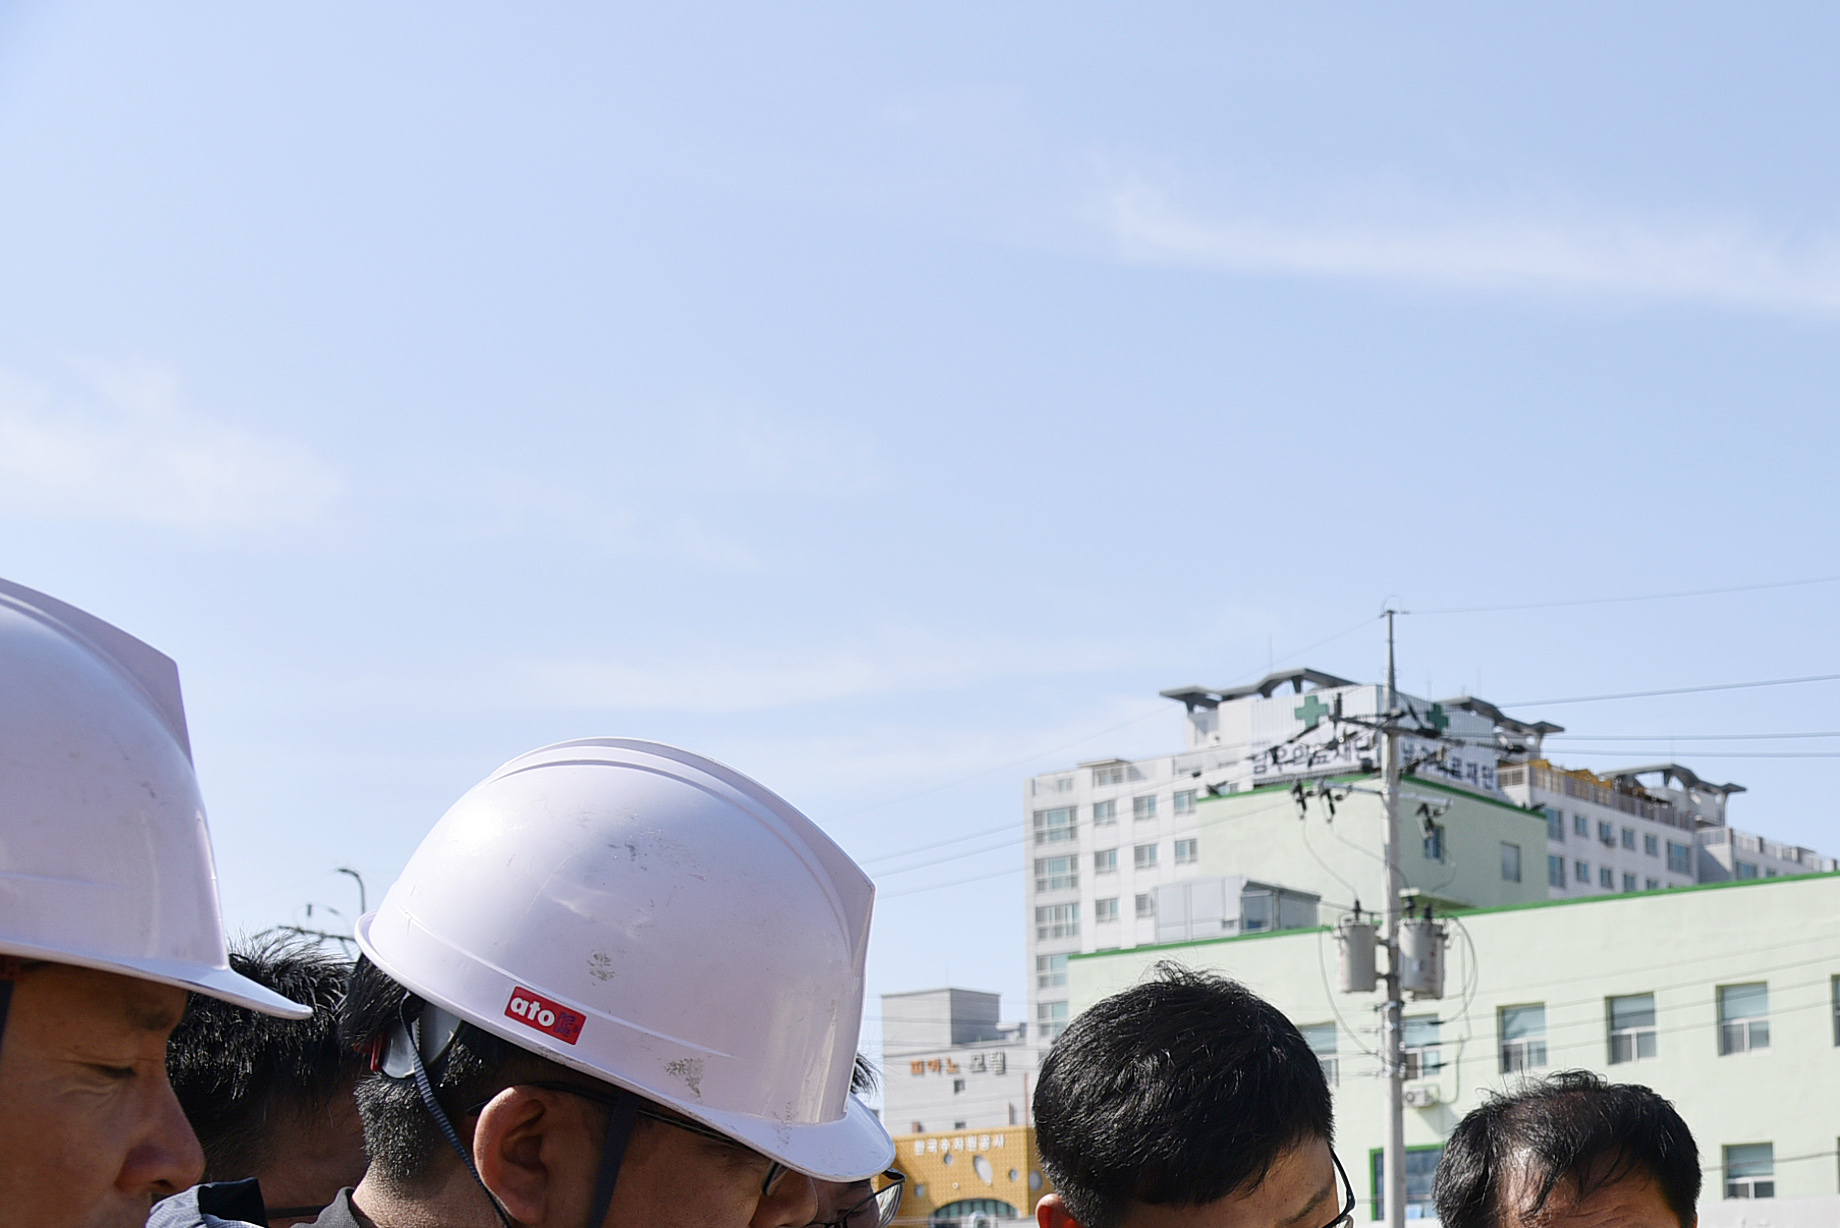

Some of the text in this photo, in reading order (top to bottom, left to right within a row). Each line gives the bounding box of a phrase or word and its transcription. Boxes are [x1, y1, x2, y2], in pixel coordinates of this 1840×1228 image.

[910, 1051, 1006, 1074] 피아노 모텔
[914, 1134, 1005, 1155] 한국수자원공사
